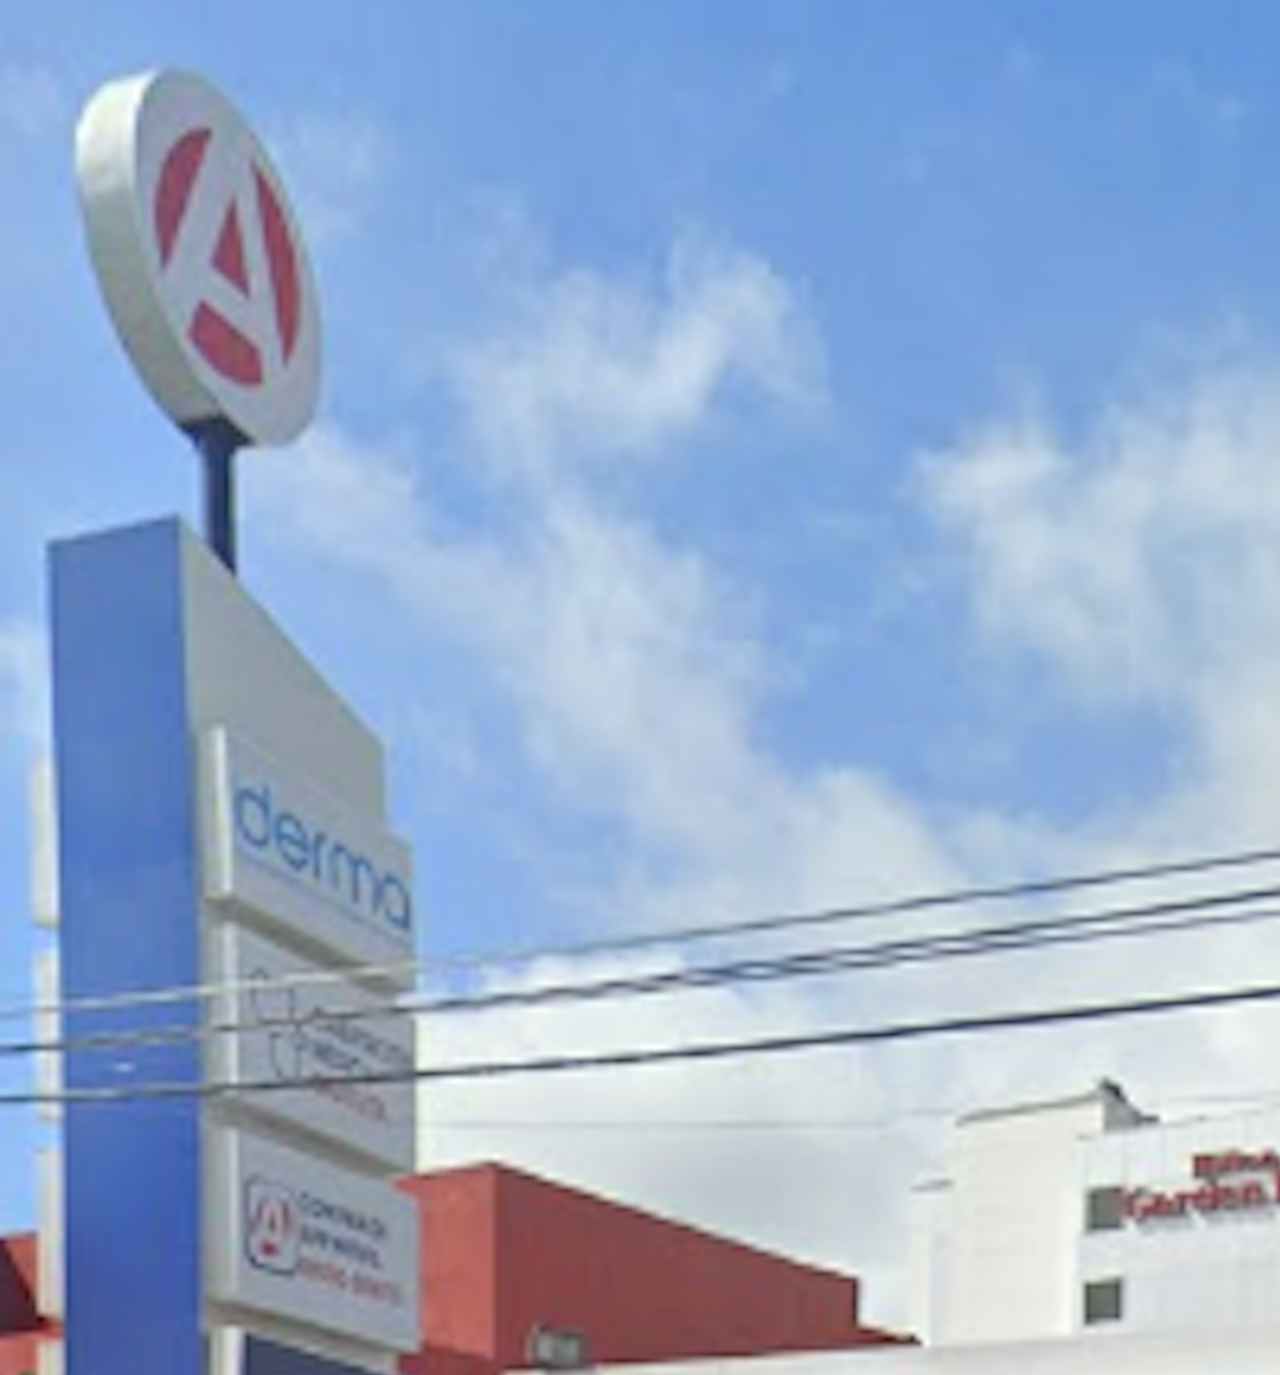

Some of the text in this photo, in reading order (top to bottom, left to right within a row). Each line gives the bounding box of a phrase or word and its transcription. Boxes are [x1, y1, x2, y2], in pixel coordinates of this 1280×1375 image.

[154, 126, 304, 388] A
[235, 784, 411, 931] derma
[1122, 1182, 1266, 1221] Garden
